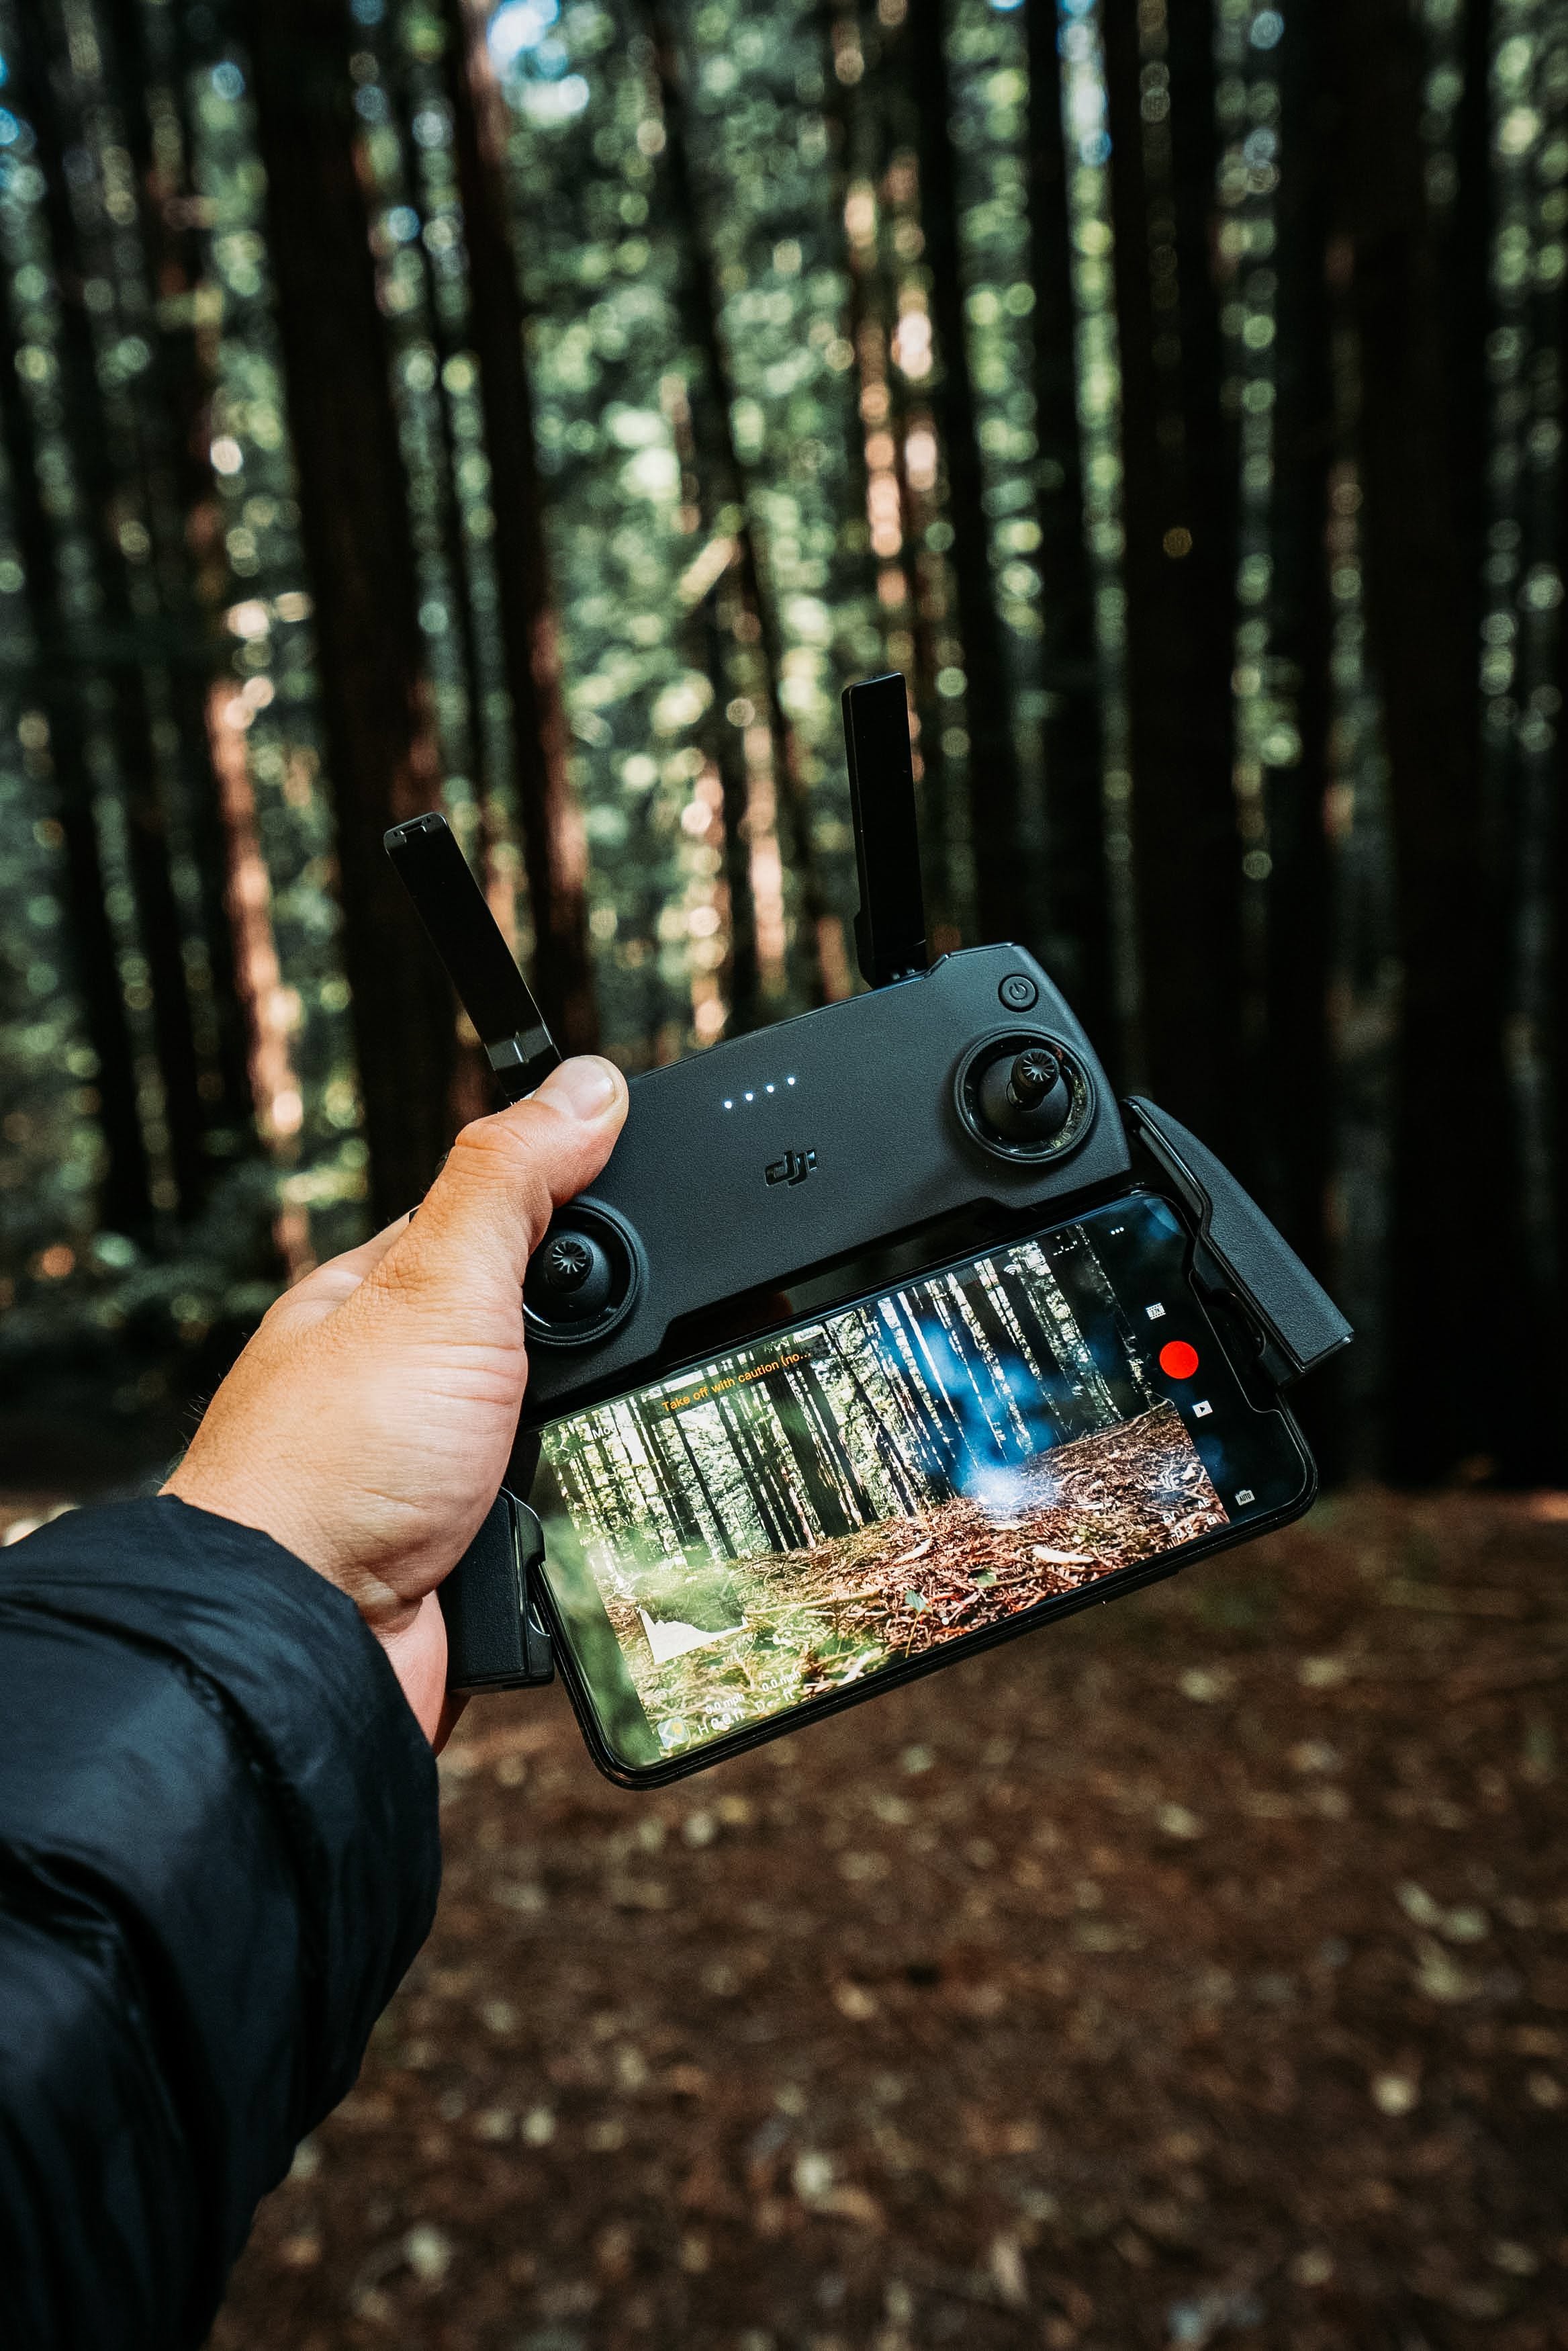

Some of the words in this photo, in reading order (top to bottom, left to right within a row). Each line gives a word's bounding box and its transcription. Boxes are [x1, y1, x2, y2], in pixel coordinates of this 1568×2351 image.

[661, 1396, 690, 1412] Take
[693, 1386, 709, 1401] off
[711, 1377, 736, 1393] with
[738, 1361, 780, 1383] caution
[1197, 1497, 1211, 1510] AE
[1239, 1493, 1252, 1503] AUTO
[1162, 1513, 1177, 1522] EV
[762, 1679, 778, 1693] 0.0
[780, 1671, 802, 1685] mph
[723, 1692, 745, 1708] mph
[782, 1688, 795, 1701] ft
[697, 1724, 709, 1736] H
